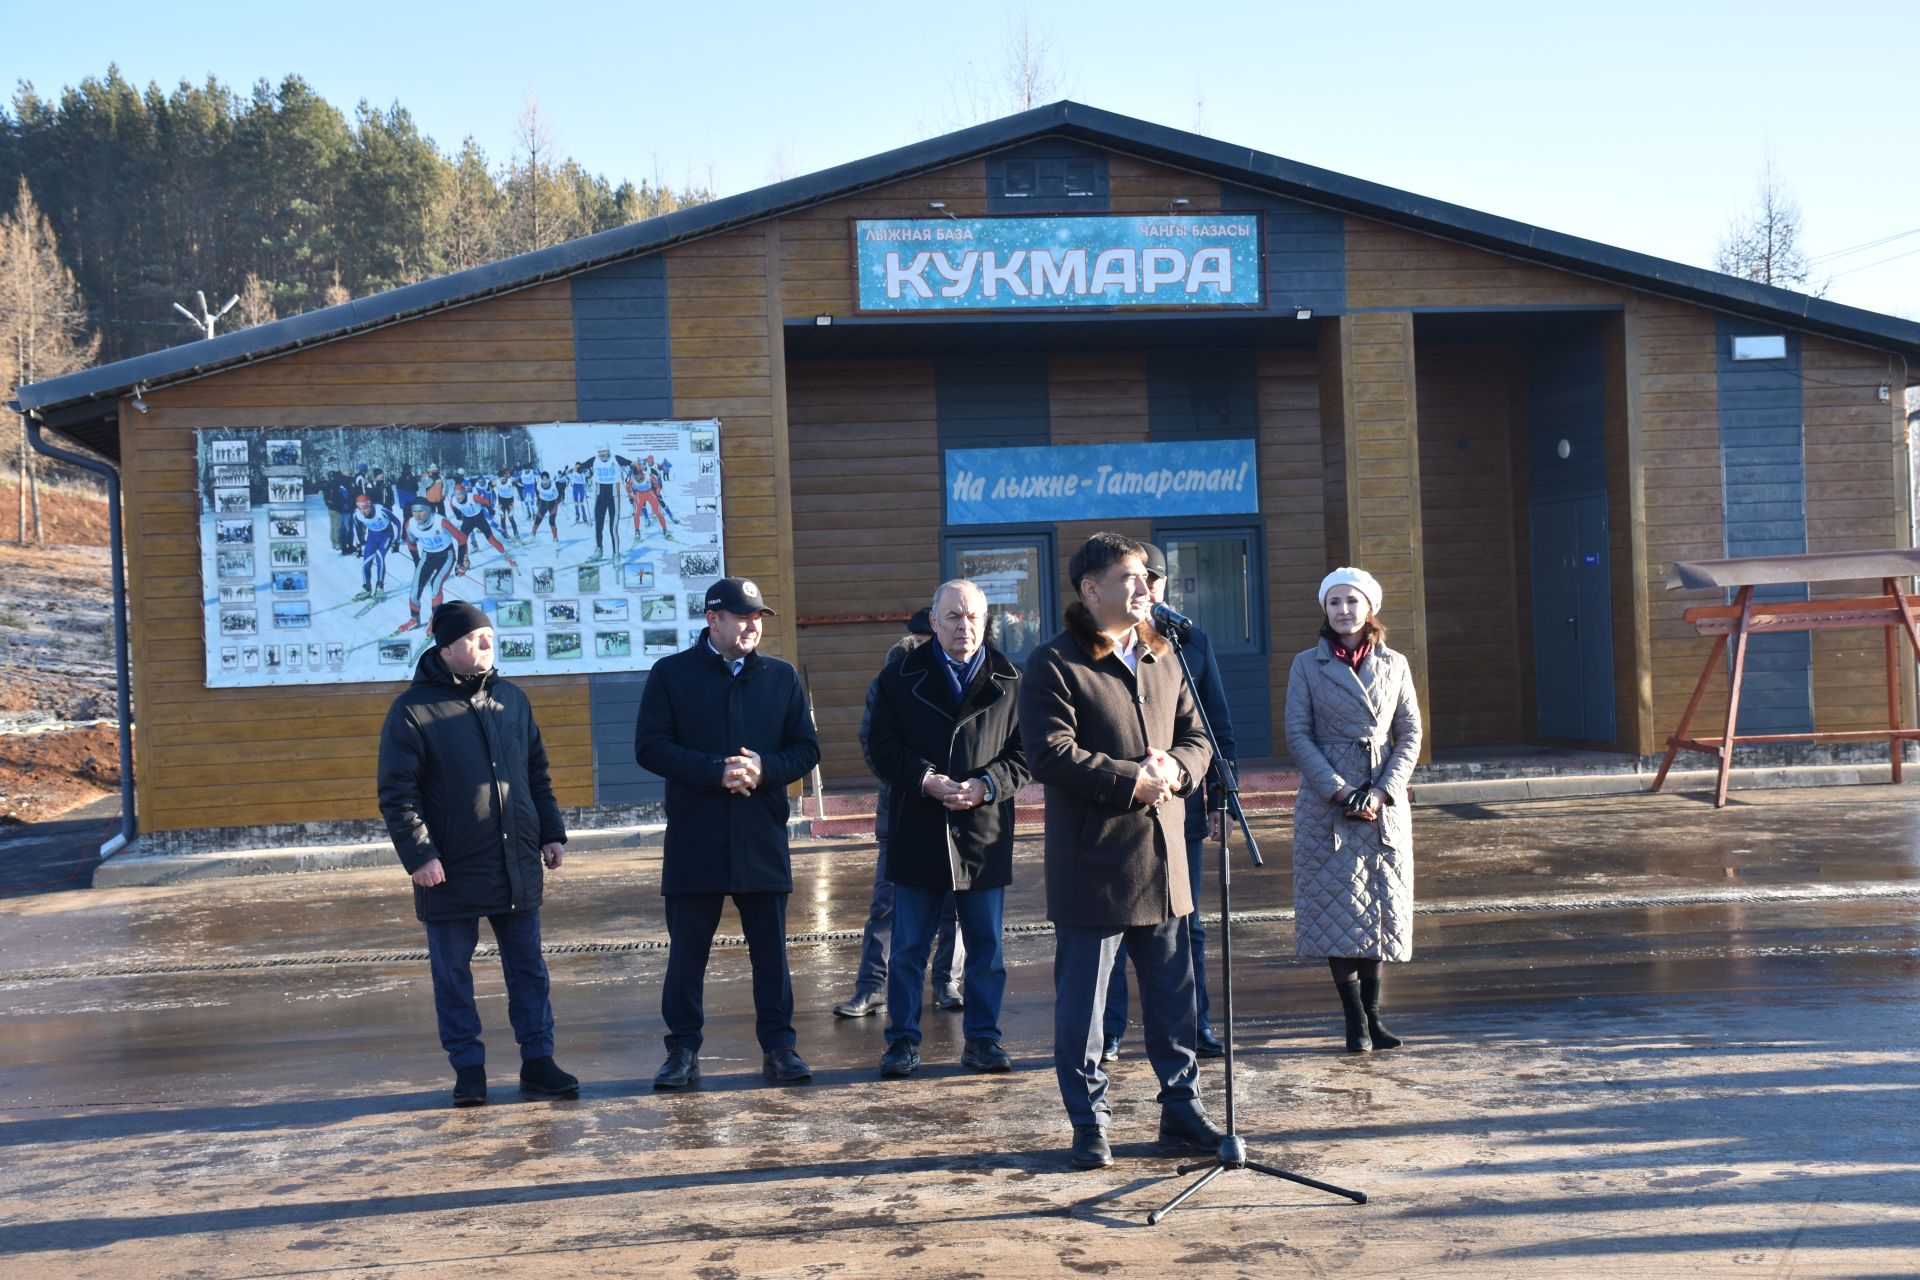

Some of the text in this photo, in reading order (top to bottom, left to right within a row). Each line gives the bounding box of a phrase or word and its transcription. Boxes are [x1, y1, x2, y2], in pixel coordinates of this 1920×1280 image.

[865, 227, 974, 241] ЛЫЖНАЯ БАЗА
[1192, 223, 1250, 237] БАЗАСЫ
[886, 246, 1232, 298] КУКМАРА
[952, 470, 985, 501] На
